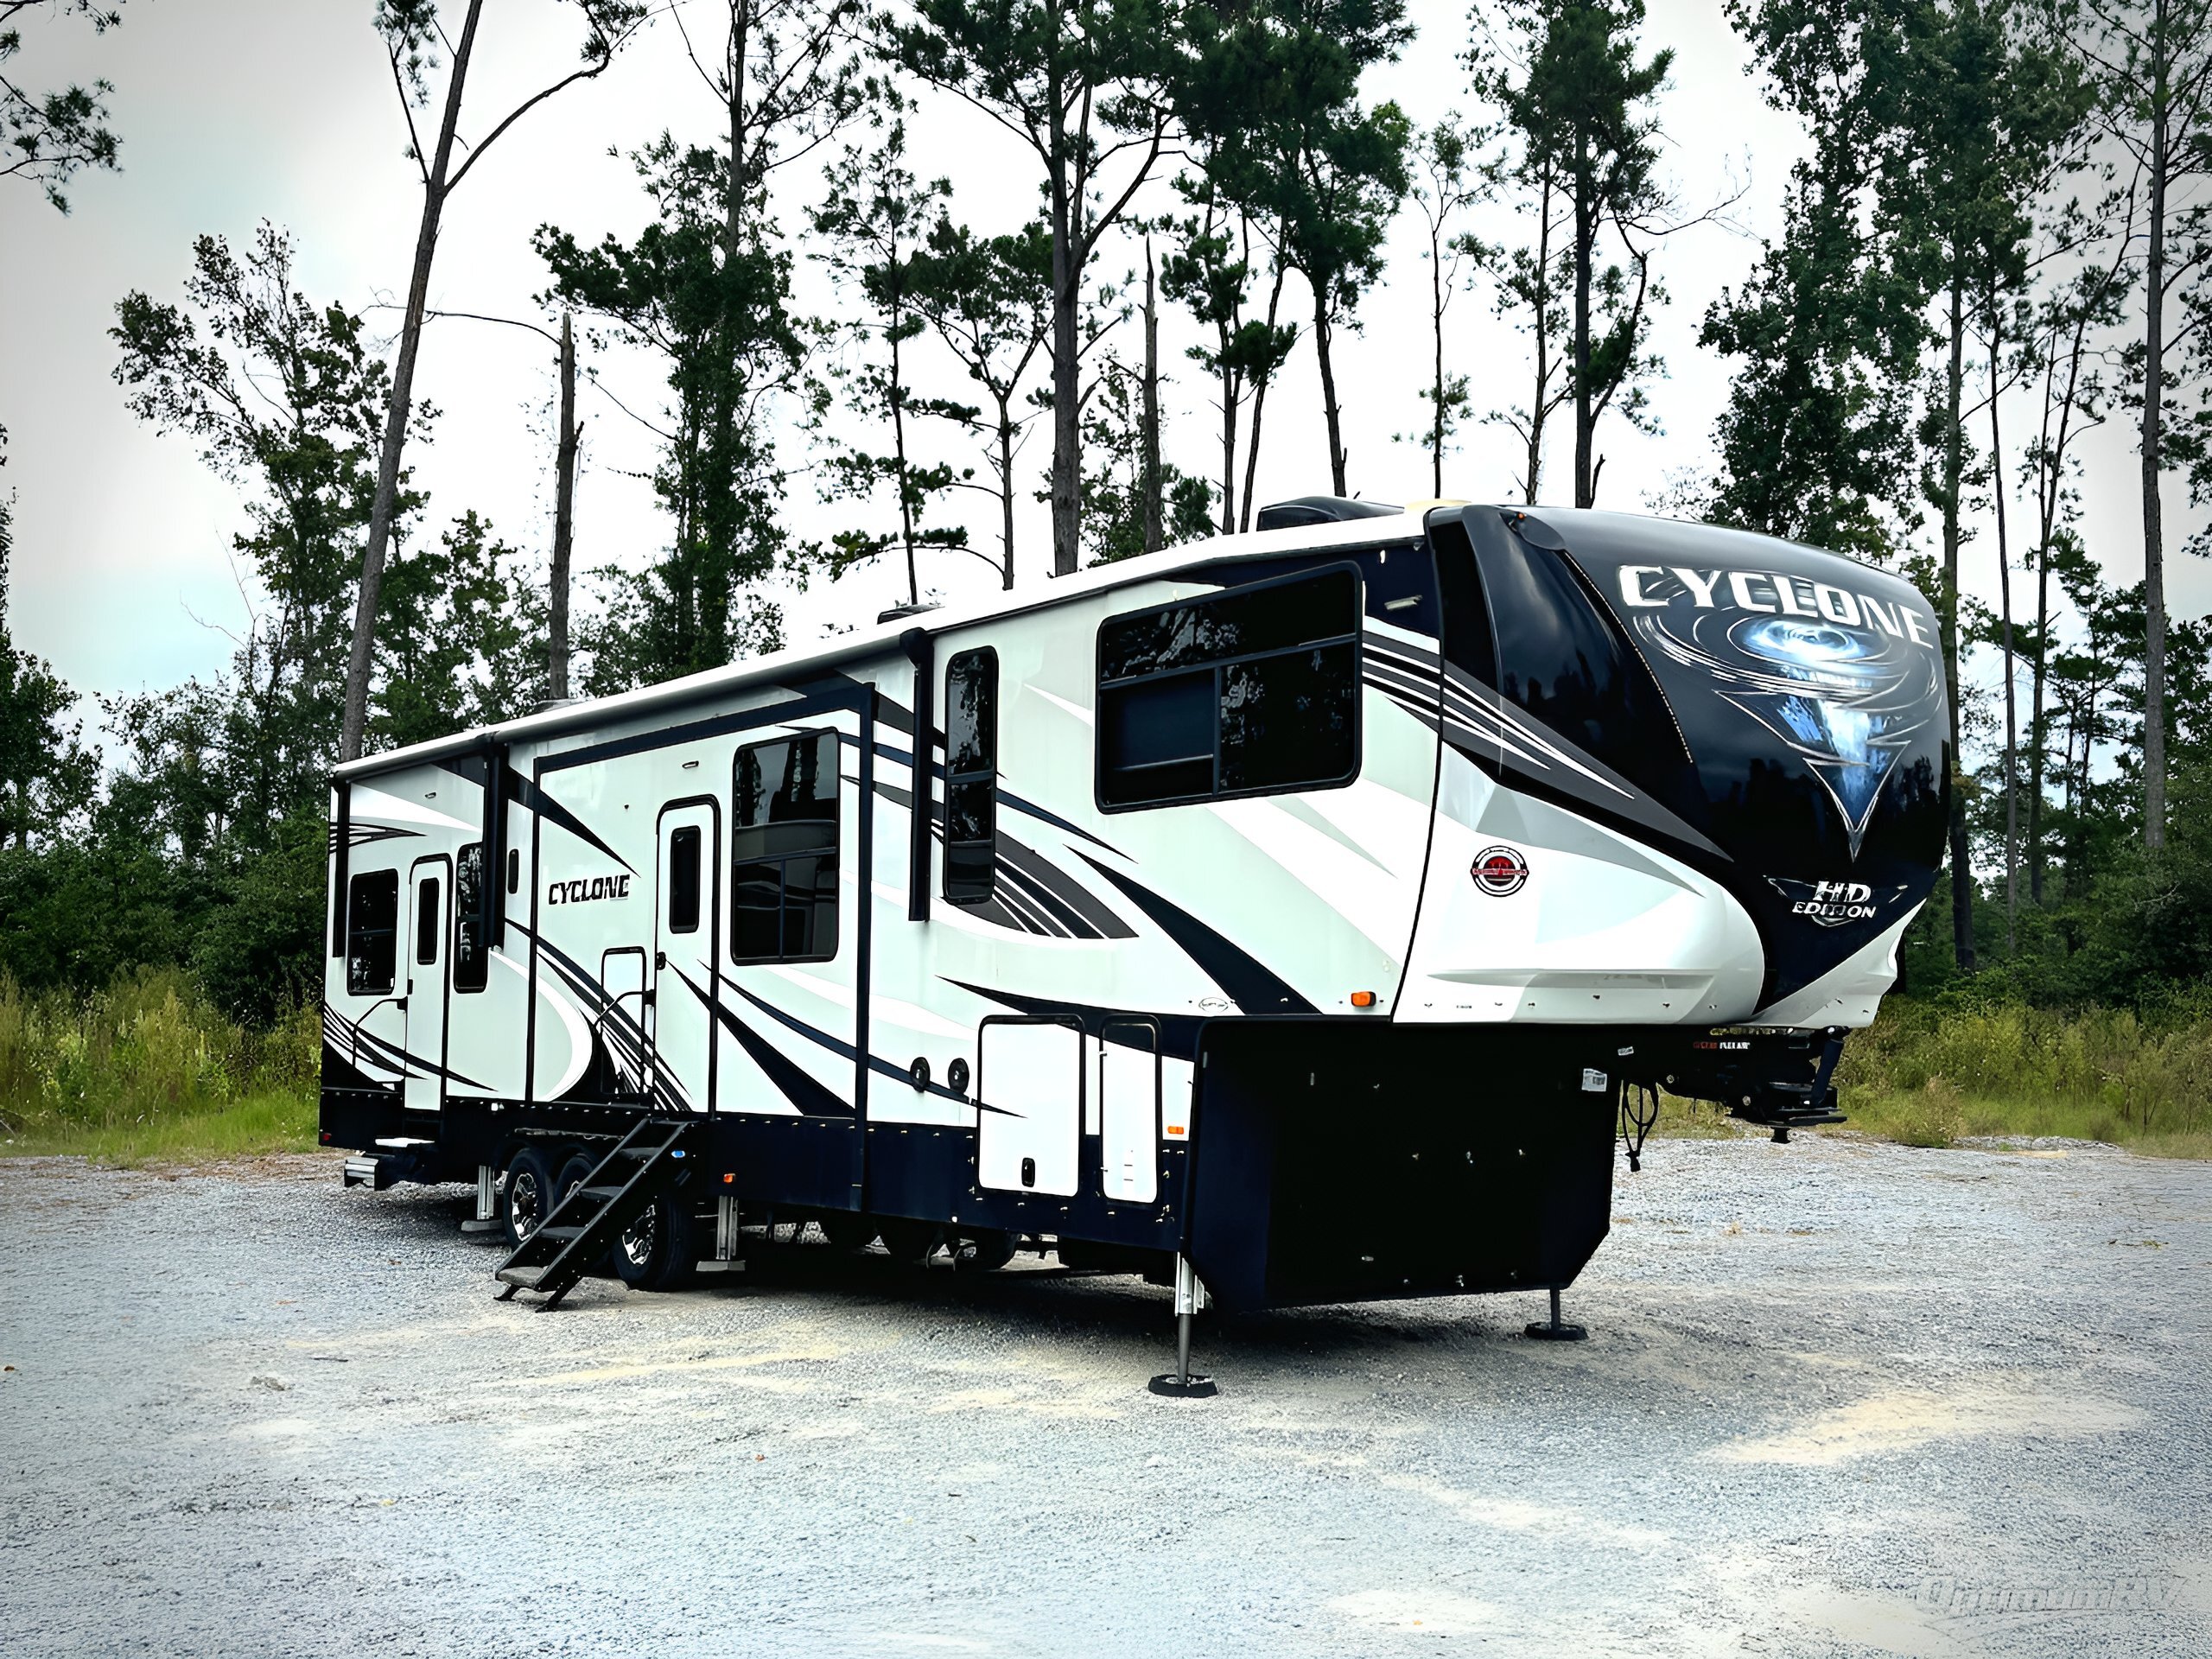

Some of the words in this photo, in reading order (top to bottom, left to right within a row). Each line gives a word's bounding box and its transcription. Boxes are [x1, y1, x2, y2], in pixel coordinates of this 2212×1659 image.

[1618, 564, 1934, 649] CYCLONE
[549, 874, 630, 905] CYCLONE
[1813, 880, 1872, 903] HD
[1792, 901, 1877, 918] EDITION
